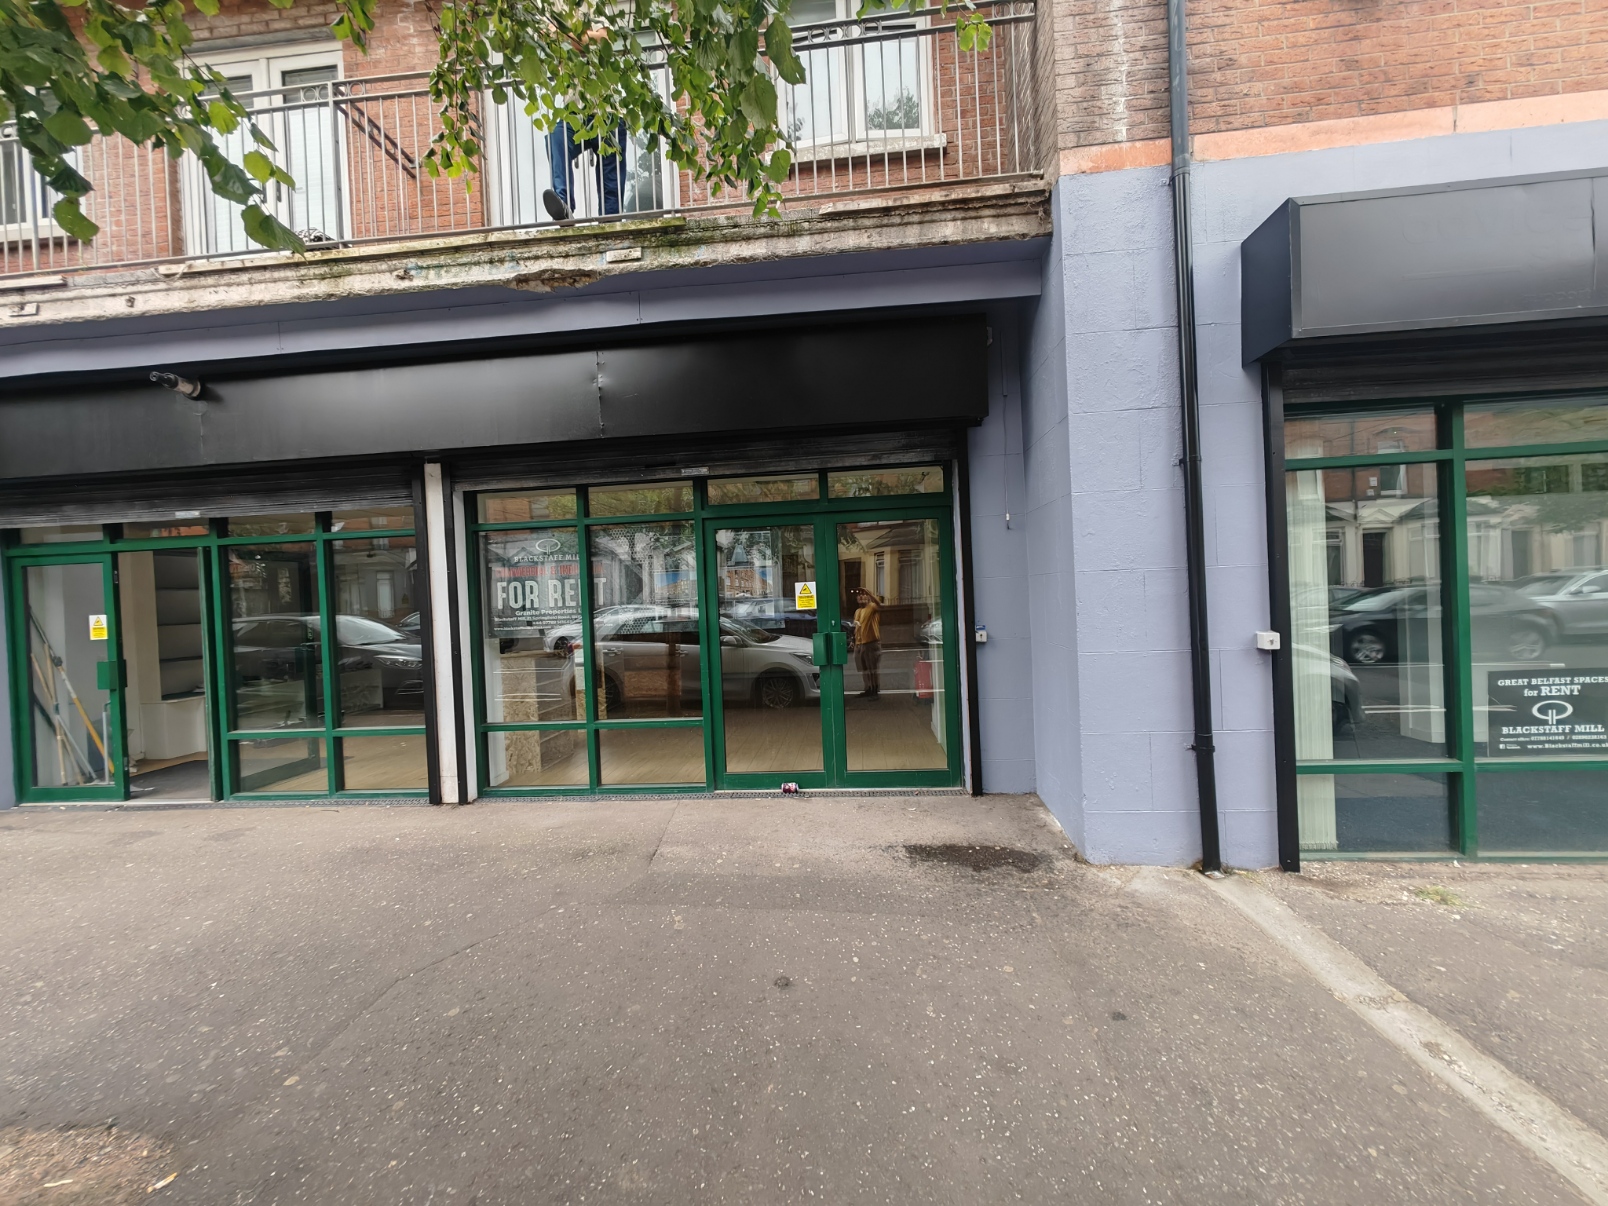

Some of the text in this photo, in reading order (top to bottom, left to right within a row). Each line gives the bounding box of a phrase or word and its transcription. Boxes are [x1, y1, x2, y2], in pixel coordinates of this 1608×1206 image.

[497, 578, 607, 609] FOR RET
[1498, 676, 1608, 686] GREAT BELFAST SPACES
[1524, 685, 1581, 697] for RENT
[1502, 724, 1605, 735] BLACKSTAFF MILL
